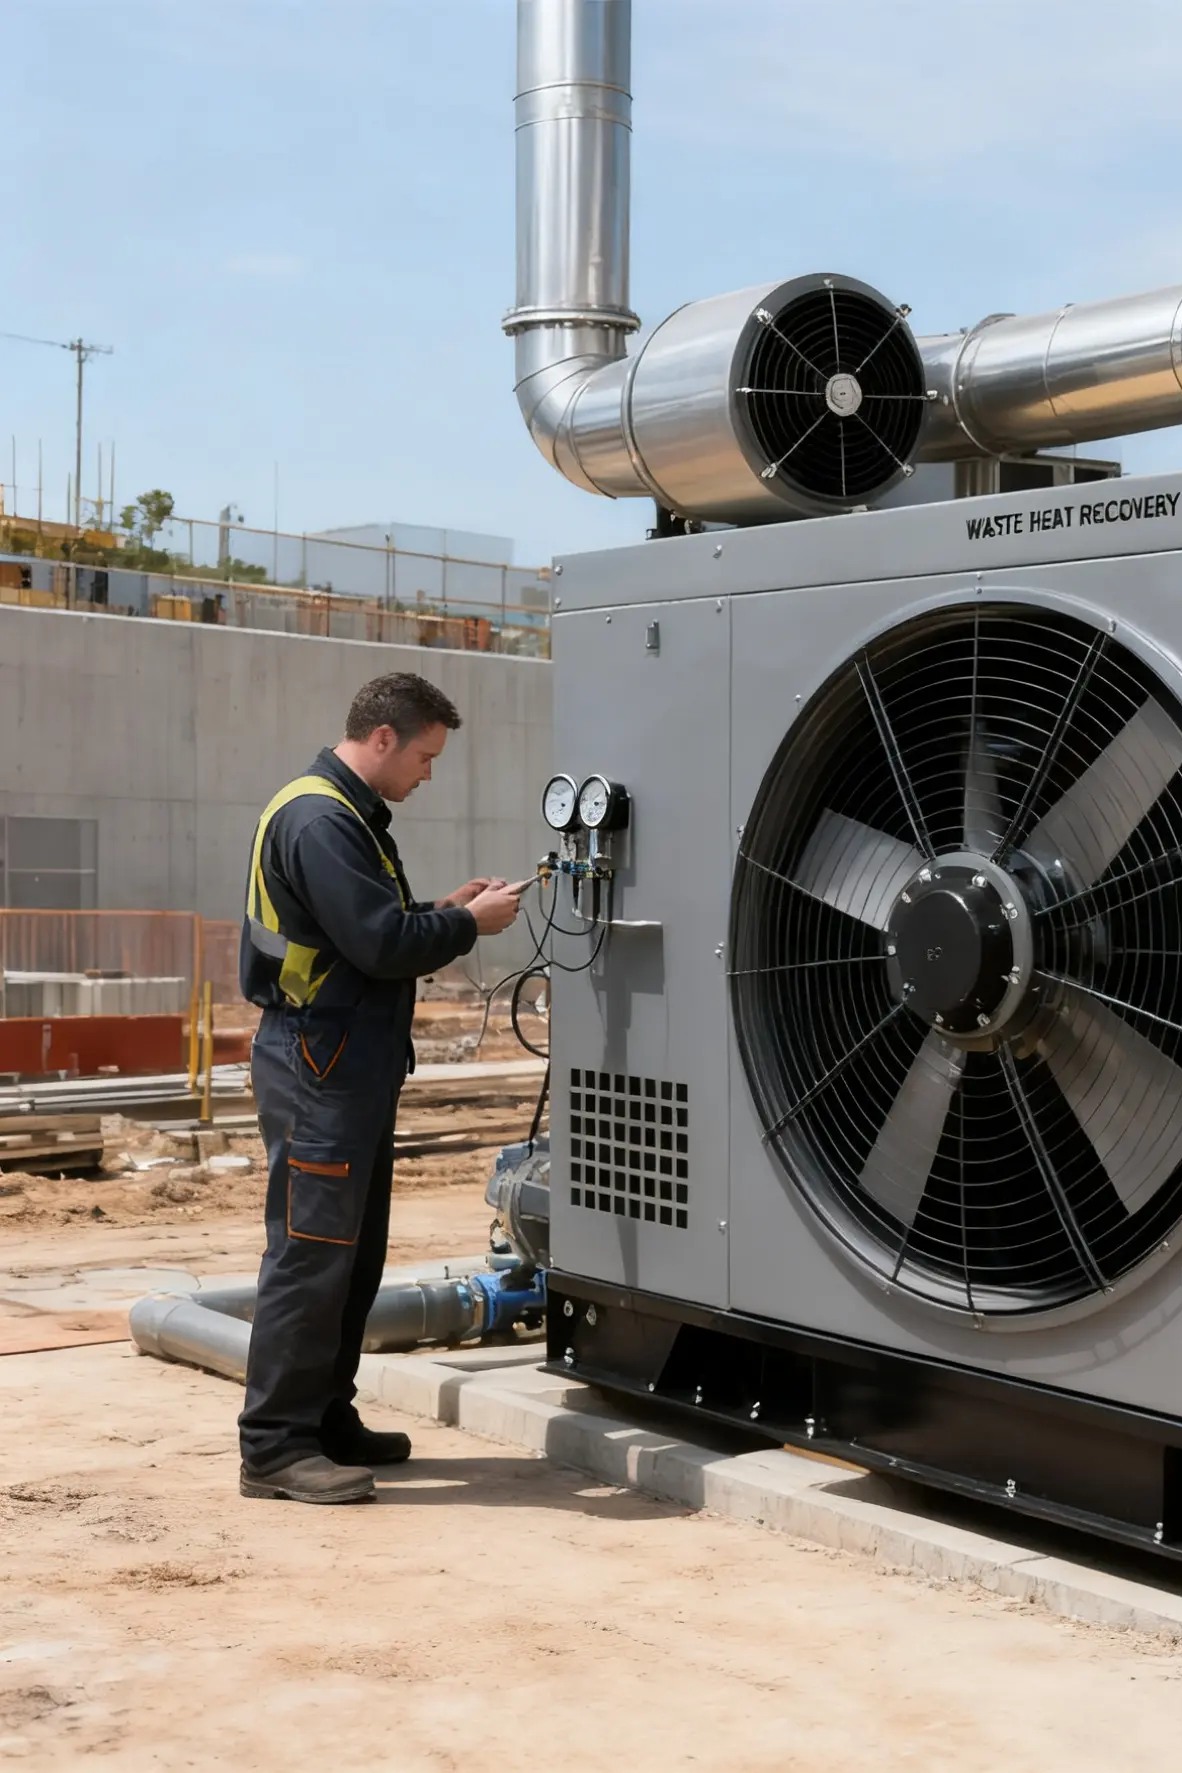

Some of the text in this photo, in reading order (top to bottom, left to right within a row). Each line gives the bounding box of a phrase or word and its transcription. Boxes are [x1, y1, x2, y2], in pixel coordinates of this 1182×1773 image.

[966, 513, 1023, 540] WASTE
[1029, 506, 1073, 532] HEAT
[1079, 491, 1181, 526] RECOVERY
